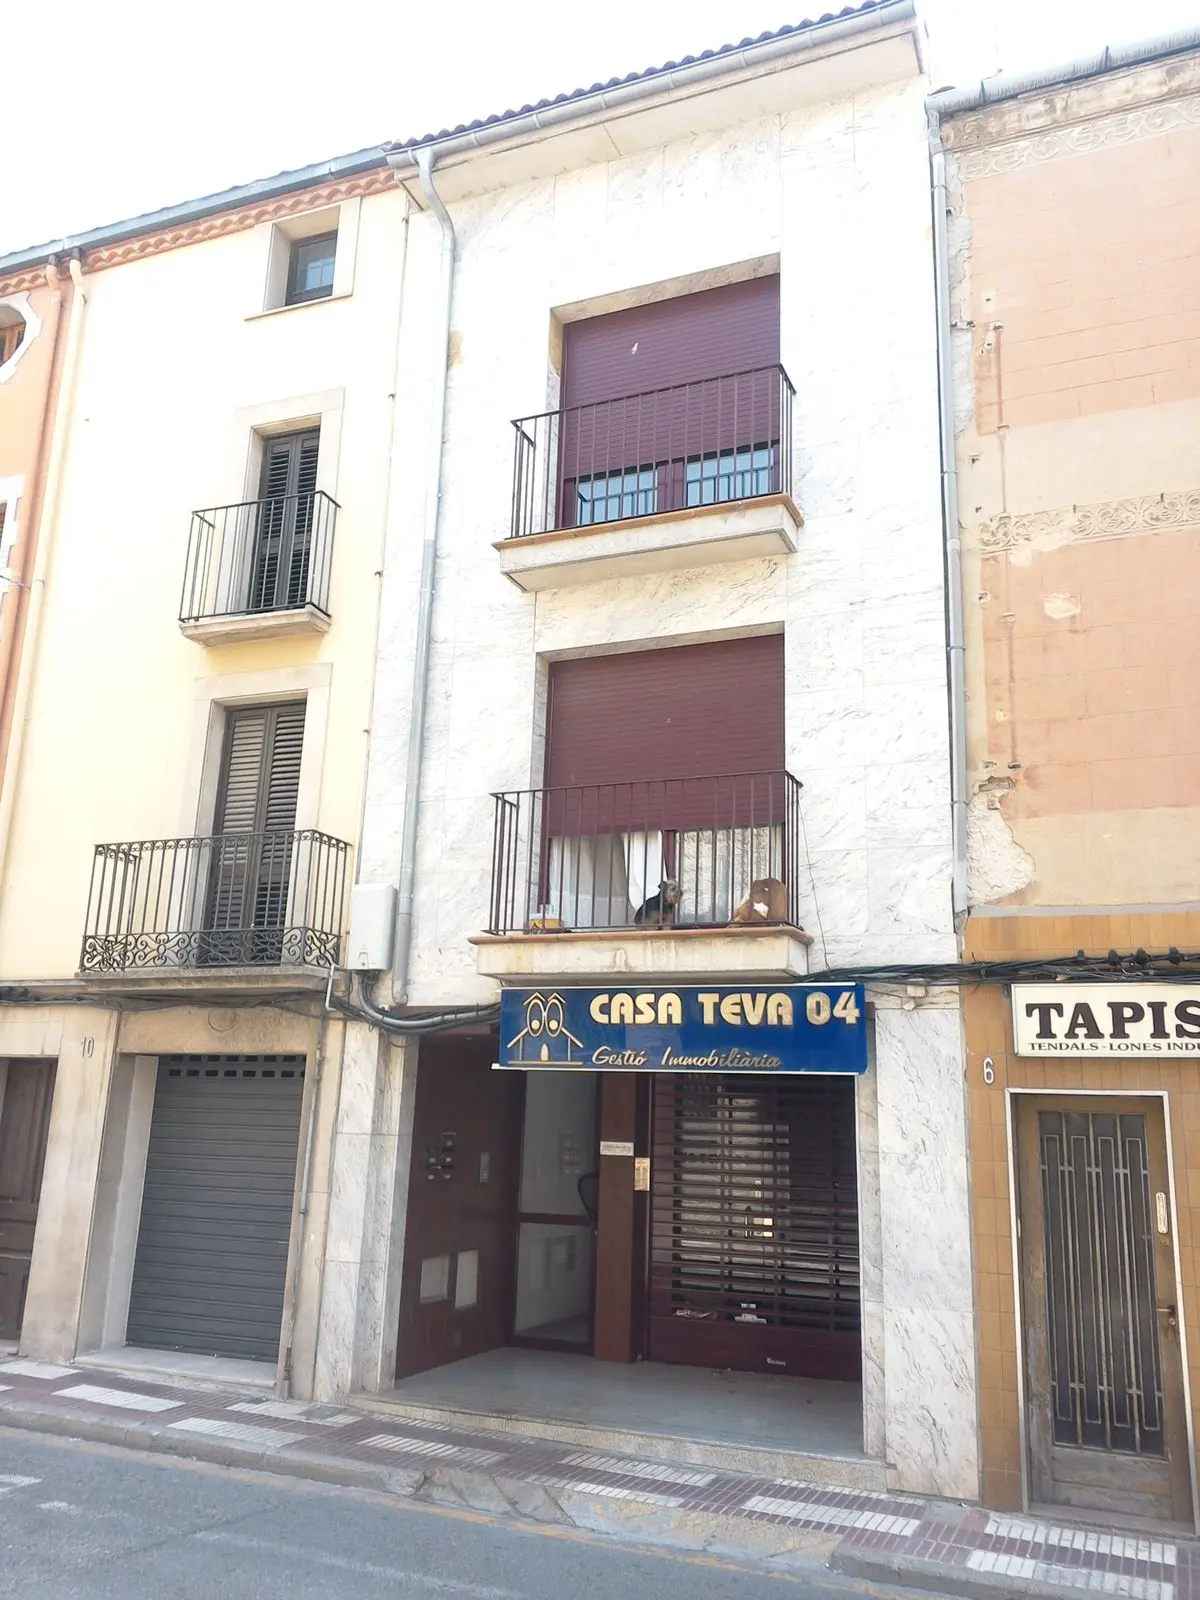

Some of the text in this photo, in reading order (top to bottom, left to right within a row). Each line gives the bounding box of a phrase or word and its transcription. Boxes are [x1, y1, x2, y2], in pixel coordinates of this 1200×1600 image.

[589, 991, 860, 1026] CASA TEVA 04
[1025, 1000, 1200, 1039] TAPIS
[81, 1036, 95, 1058] 10
[591, 1045, 782, 1067] Gestió Immobiliària
[1028, 1042, 1099, 1051] TENDALS
[1109, 1042, 1162, 1051] LONES
[983, 1057, 994, 1085] 6
